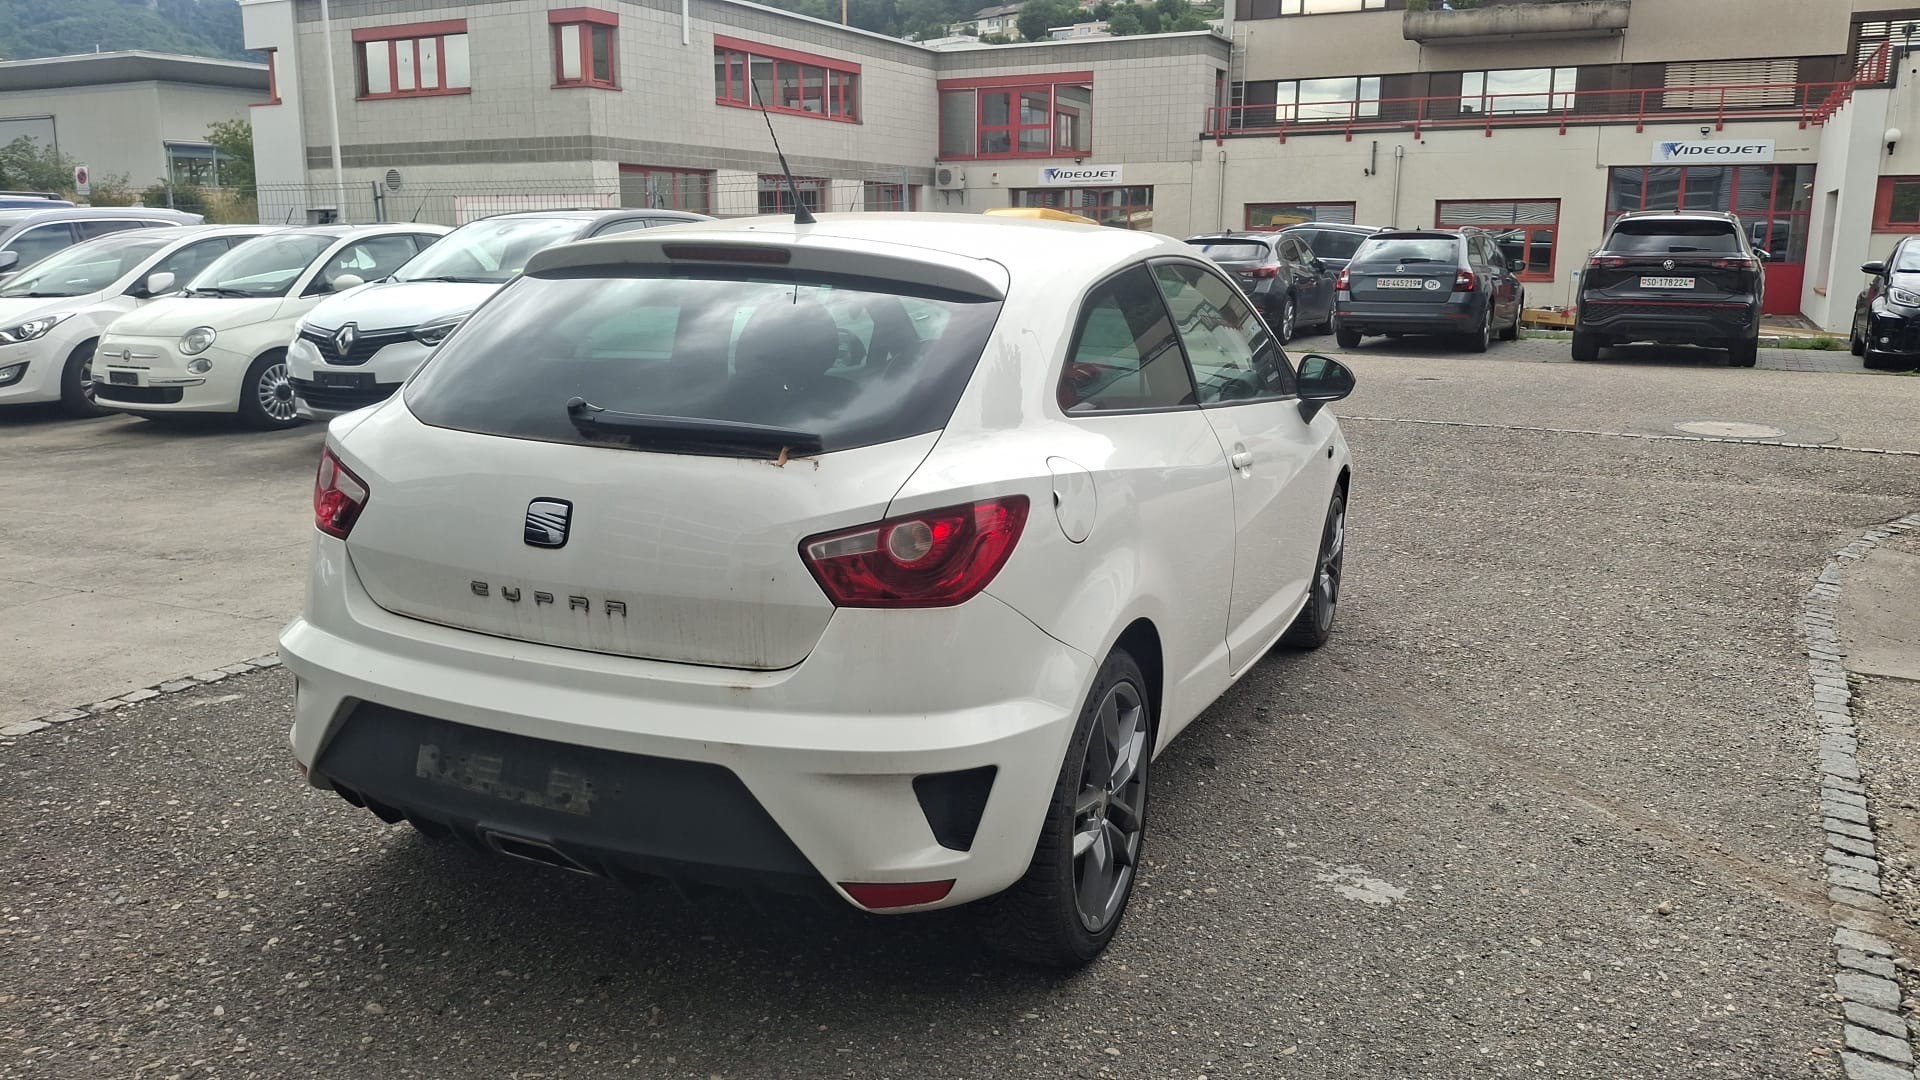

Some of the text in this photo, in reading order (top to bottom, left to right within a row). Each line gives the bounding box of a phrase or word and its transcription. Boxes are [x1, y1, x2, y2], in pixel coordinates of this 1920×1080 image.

[1668, 142, 1766, 157] VIDEOJET
[1048, 168, 1118, 181] VIDEOJET
[1427, 280, 1438, 289] CH
[470, 579, 627, 617] CUPRA
